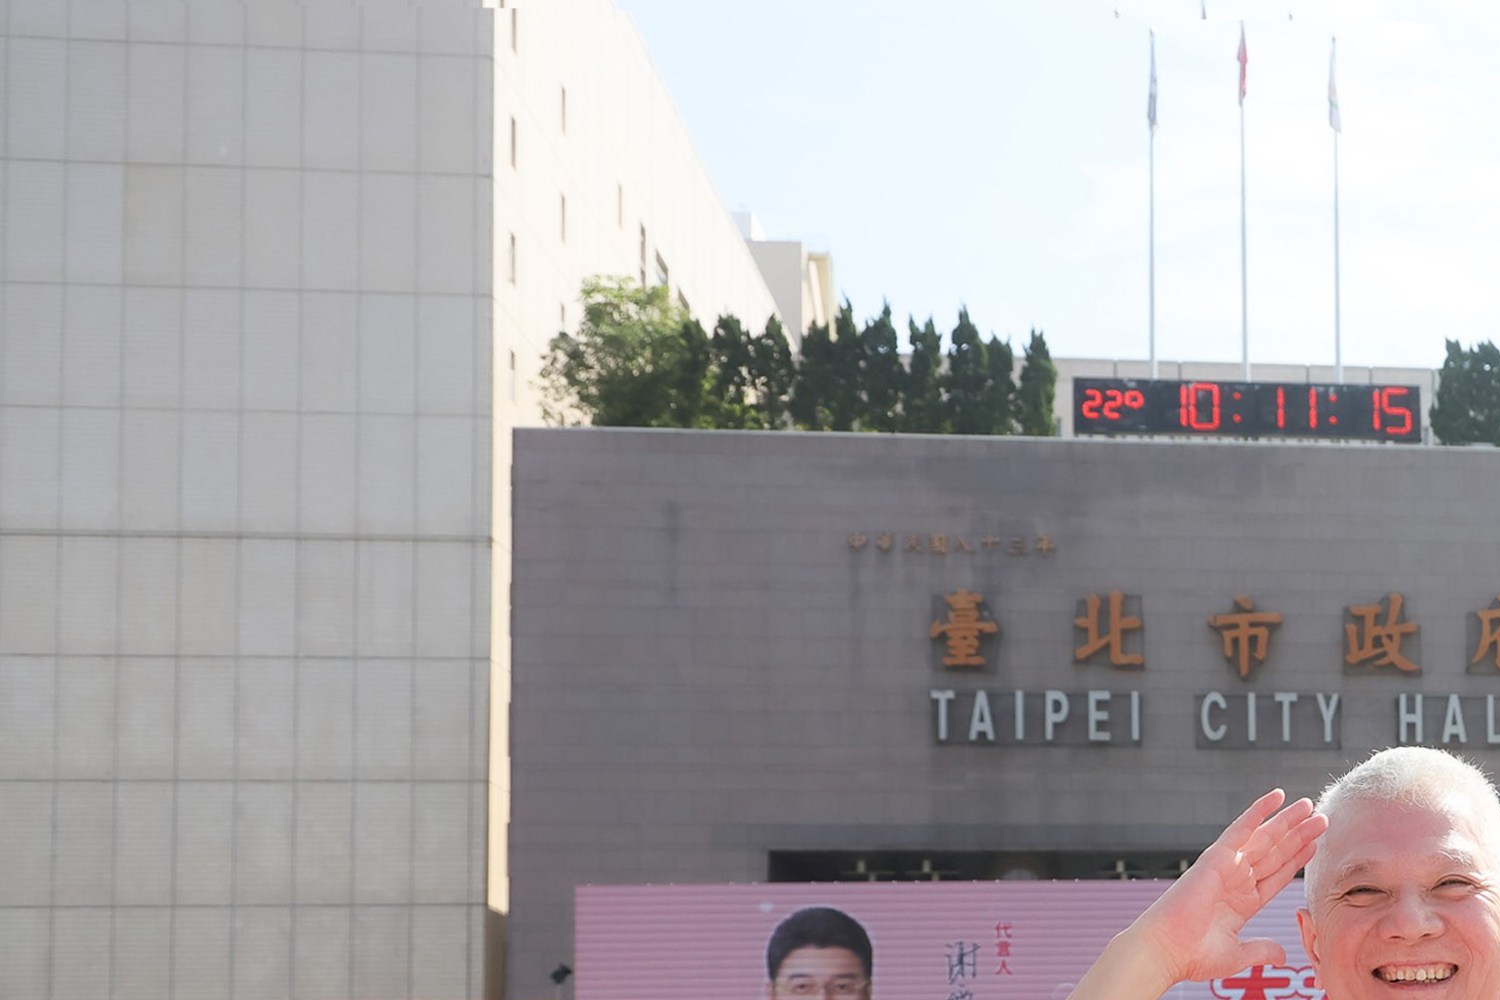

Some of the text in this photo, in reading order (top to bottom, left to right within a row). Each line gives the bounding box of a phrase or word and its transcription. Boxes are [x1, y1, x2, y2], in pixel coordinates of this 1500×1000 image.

[931, 690, 1141, 742] TAIPEI
[1201, 692, 1340, 743] CITY
[994, 922, 1013, 976] 代言人
